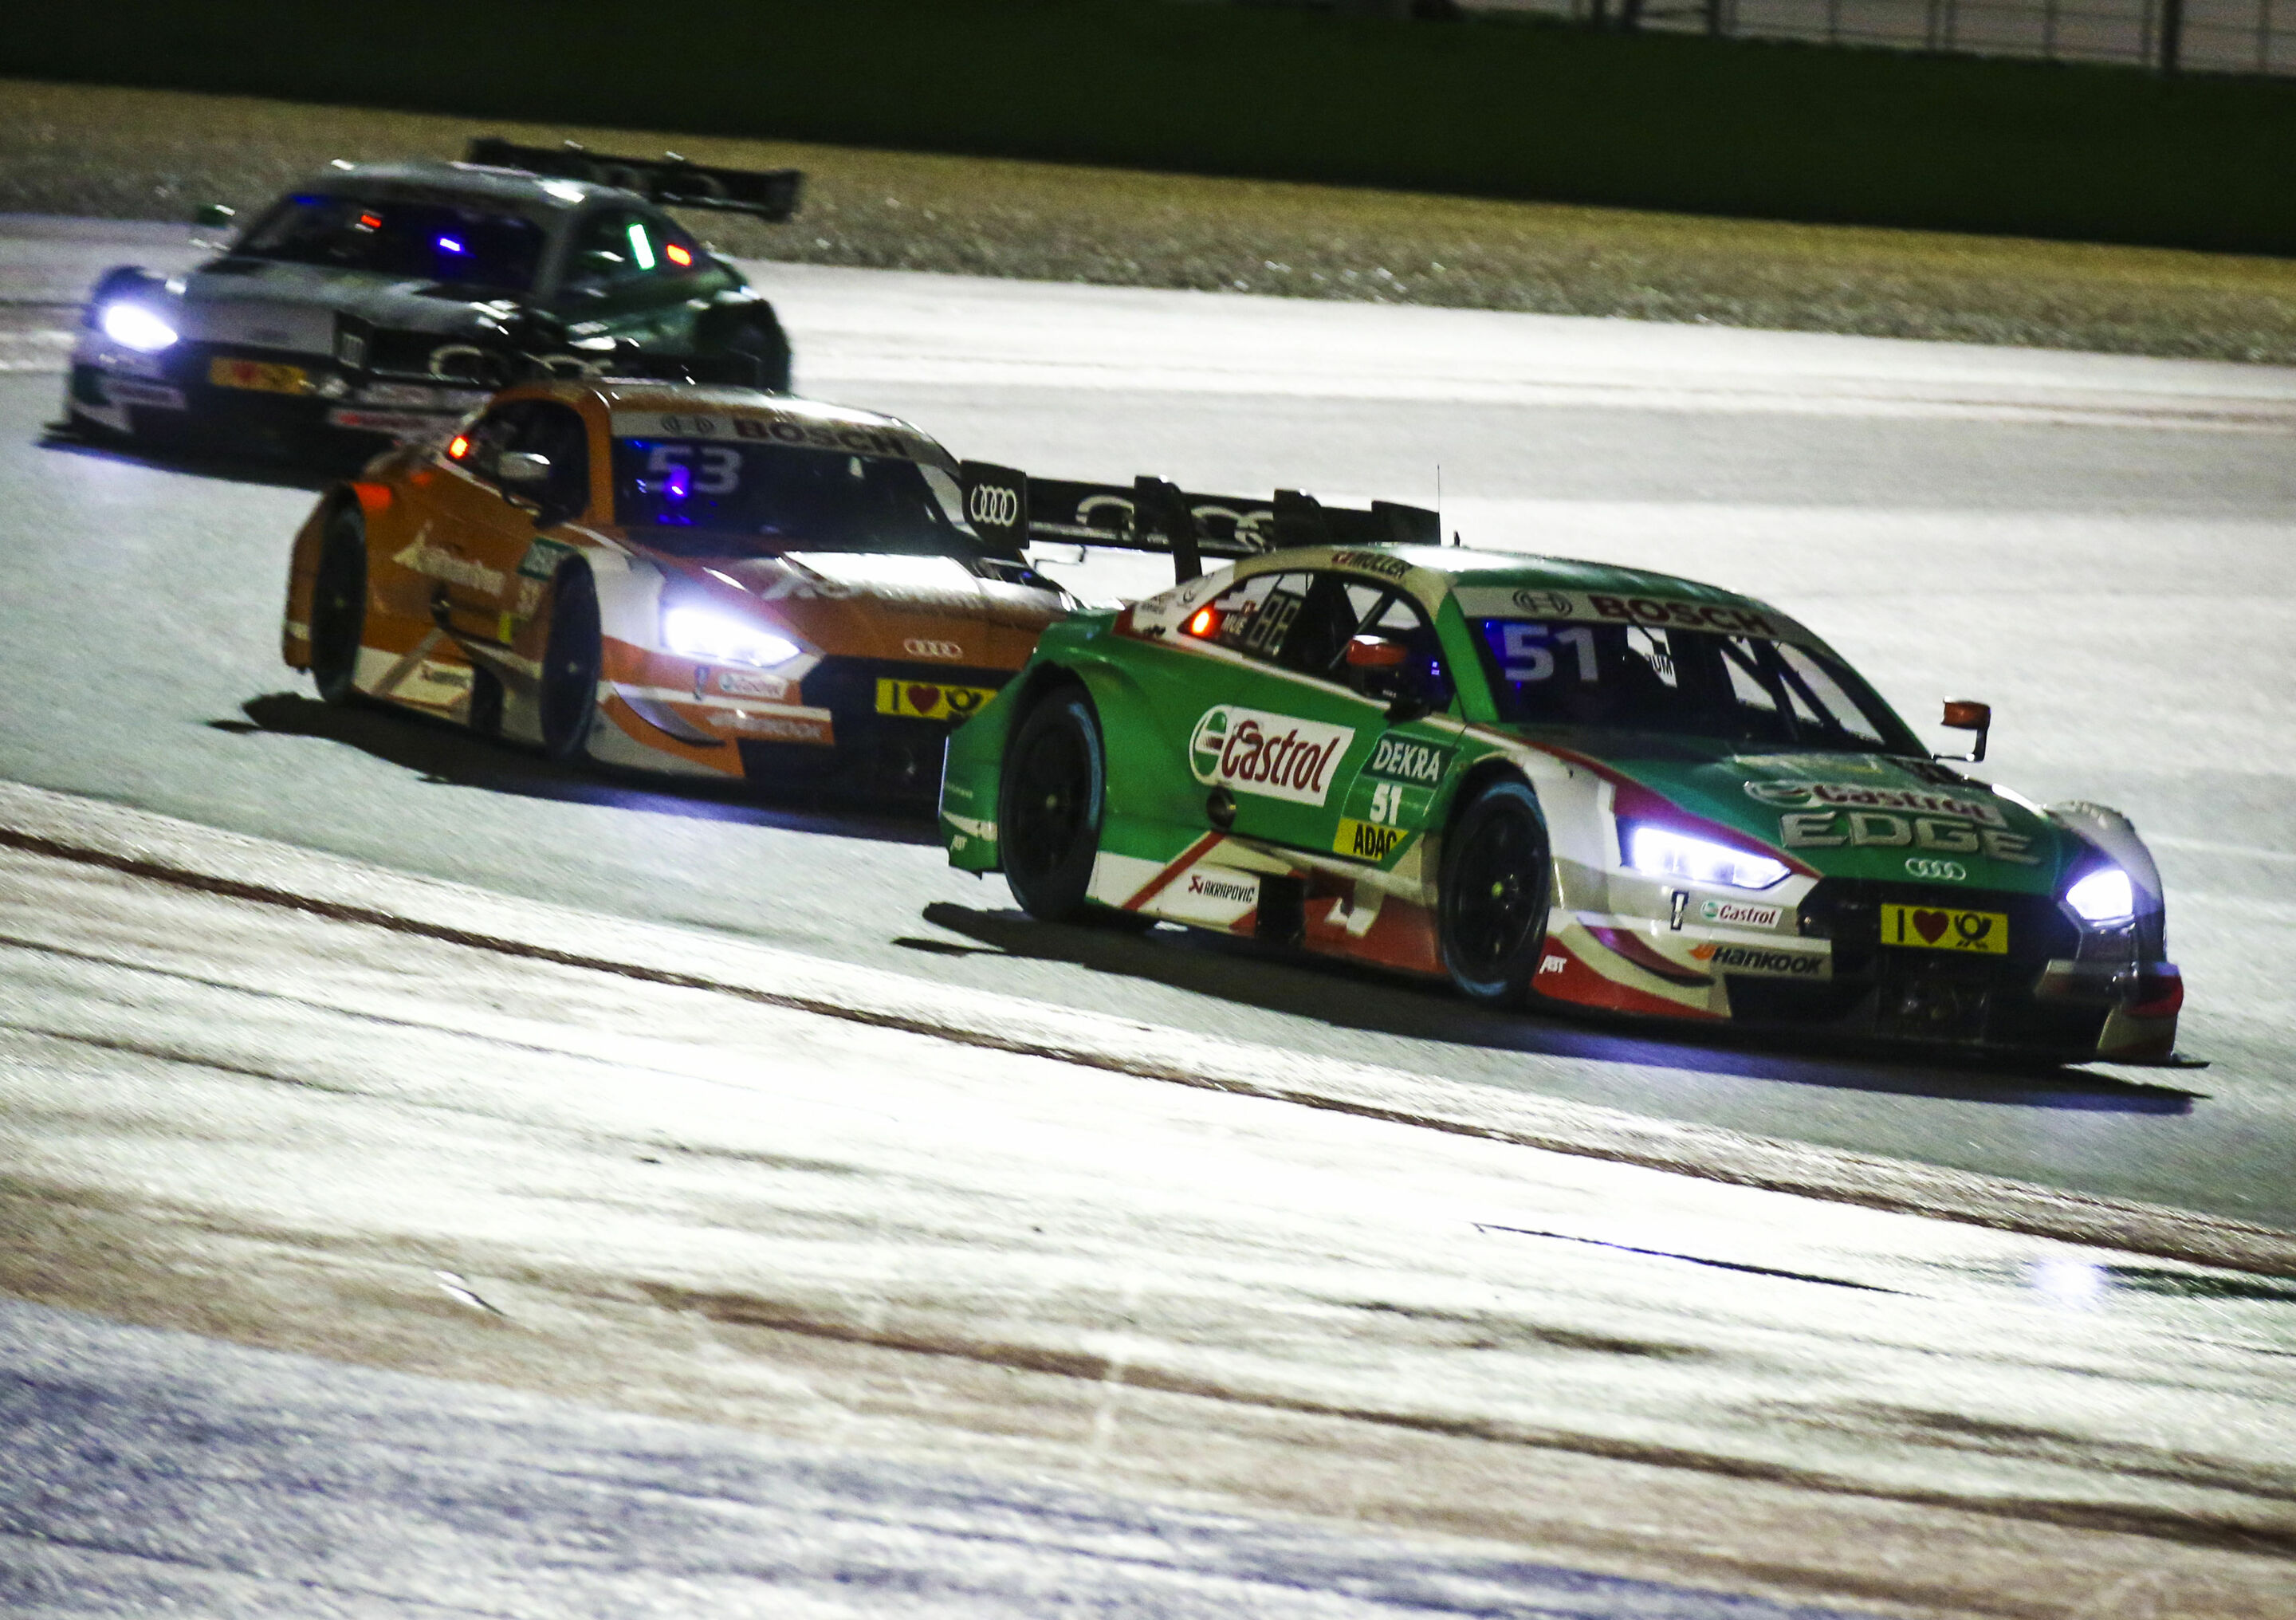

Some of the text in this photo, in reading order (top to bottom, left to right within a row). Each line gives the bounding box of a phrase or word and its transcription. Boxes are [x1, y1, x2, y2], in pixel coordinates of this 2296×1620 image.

[733, 418, 907, 455] BOSCH
[647, 444, 743, 495] 53
[1588, 594, 1778, 636] BOSCH
[1504, 623, 1599, 682] 51
[1221, 719, 1341, 793] Castrol
[1372, 738, 1441, 782] DEKRA
[1369, 783, 1403, 826] 51
[1352, 823, 1398, 859] ADAC
[1779, 811, 2042, 865] EDGE
[1717, 903, 1777, 926] Castrol
[1539, 954, 1567, 974] ABT
